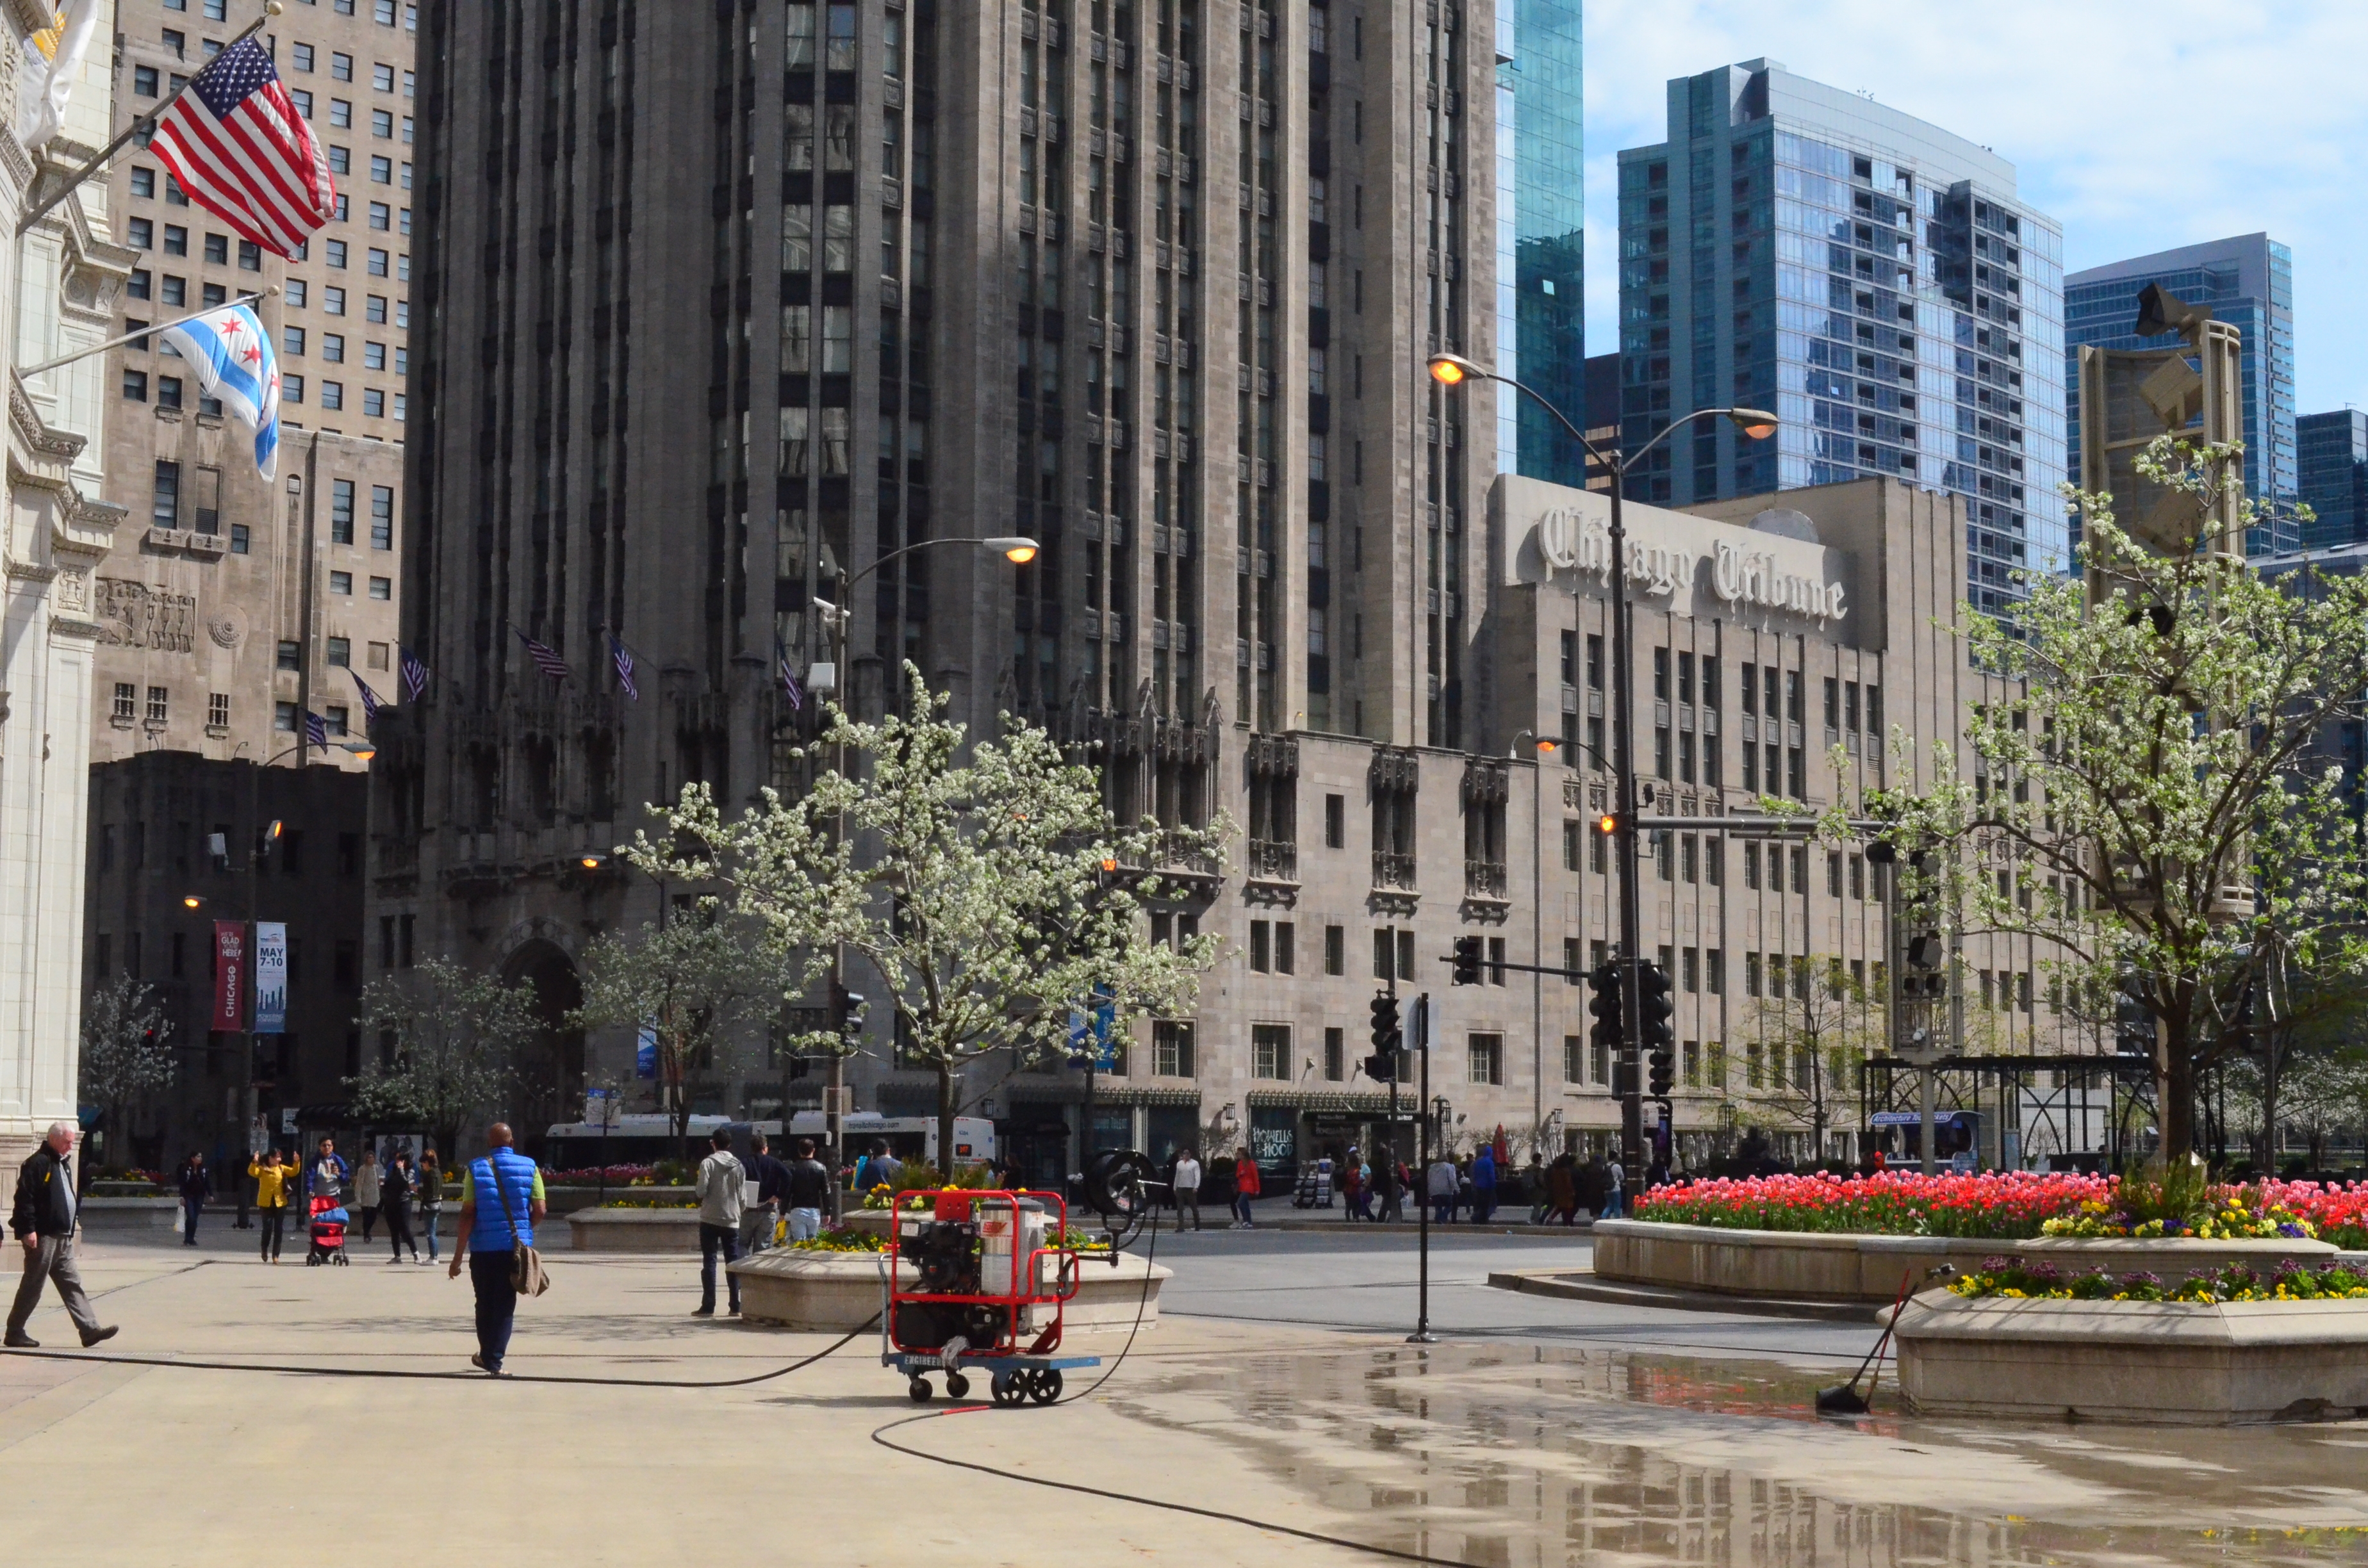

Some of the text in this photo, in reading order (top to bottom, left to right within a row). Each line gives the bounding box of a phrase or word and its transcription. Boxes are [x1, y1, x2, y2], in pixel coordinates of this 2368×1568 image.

[1539, 505, 1848, 619] Chiago Tribune
[222, 949, 242, 961] HERE!
[259, 948, 283, 957] MAY
[259, 958, 283, 967] 7-10
[226, 964, 236, 1017] CHICAGO
[848, 1122, 900, 1130] transitchicago.com
[1253, 1126, 1293, 1143] HOWELLS
[1262, 1142, 1293, 1157] HOOD
